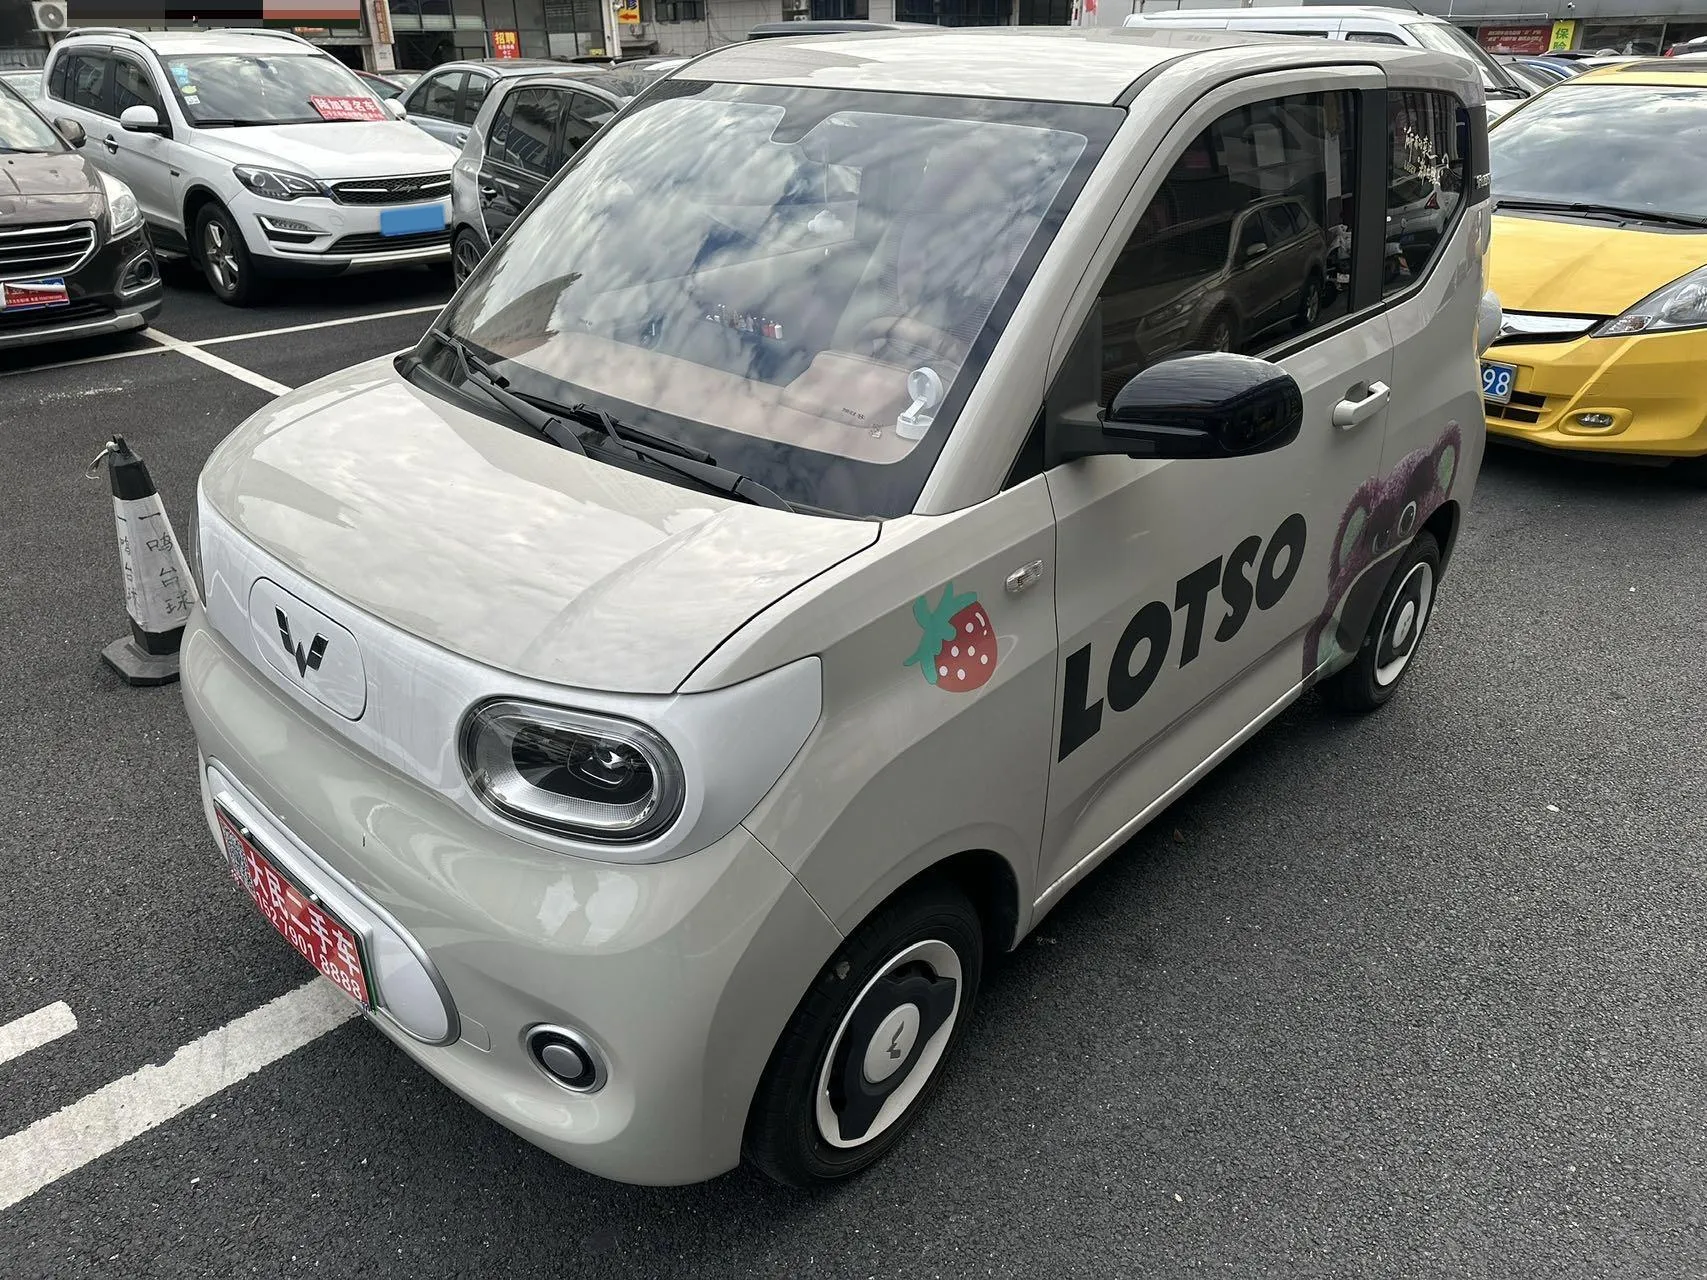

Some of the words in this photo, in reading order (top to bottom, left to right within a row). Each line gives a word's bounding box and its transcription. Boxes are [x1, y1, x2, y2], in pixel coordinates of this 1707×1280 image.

[494, 32, 515, 45] 招聘
[1553, 28, 1569, 49] 保险
[1483, 369, 1510, 396] 98
[1058, 512, 1307, 763] LOTSO
[247, 850, 360, 977] 大民二手车
